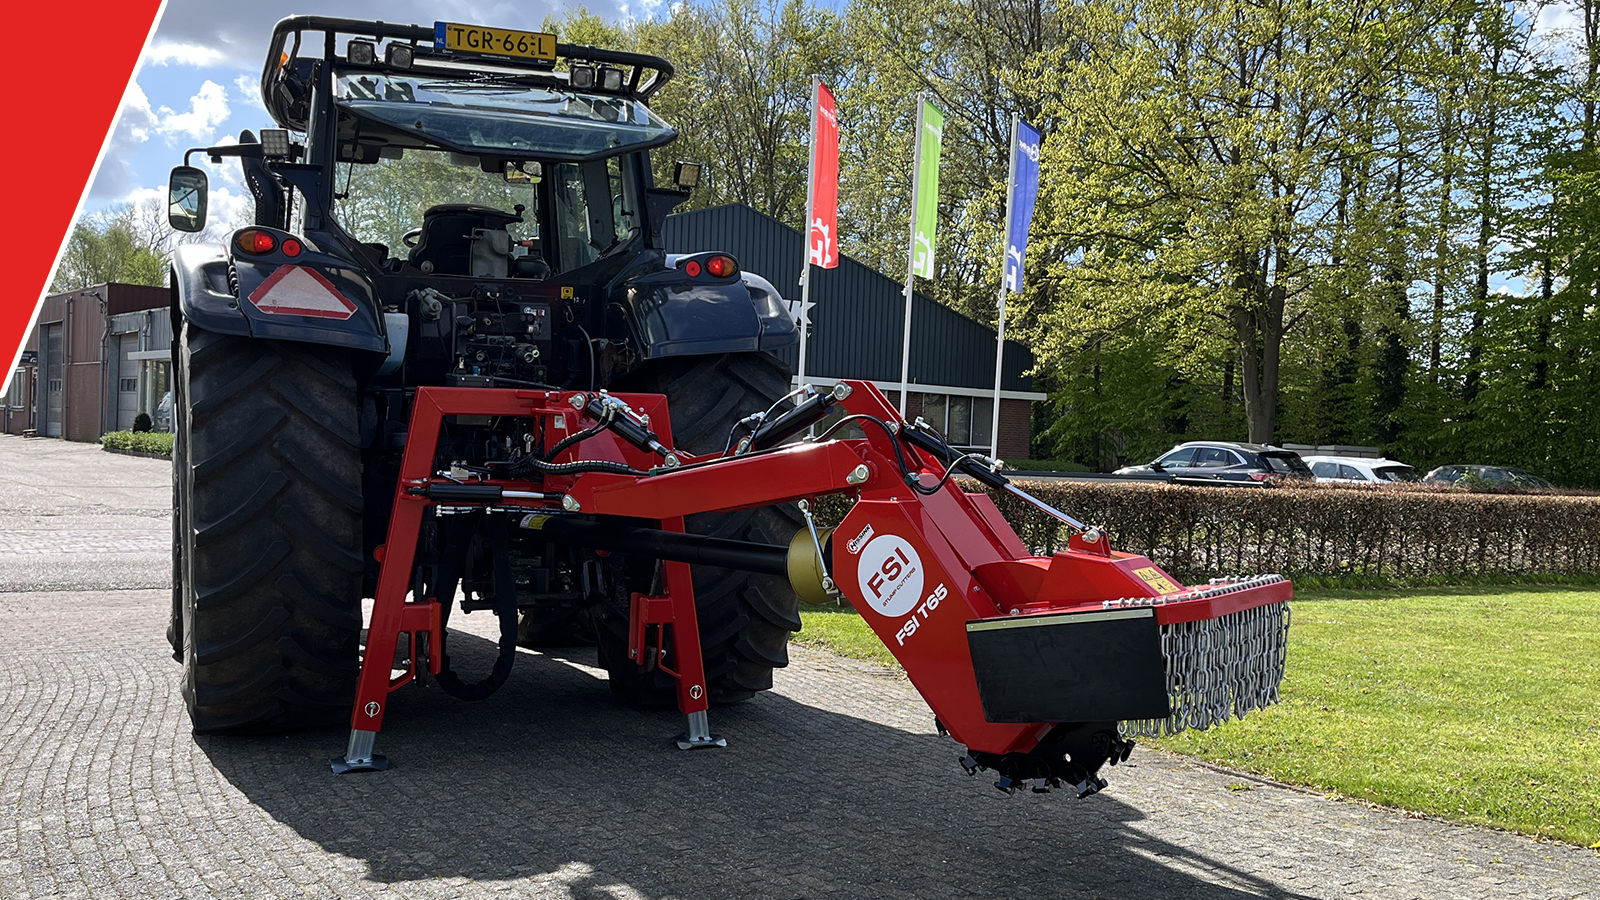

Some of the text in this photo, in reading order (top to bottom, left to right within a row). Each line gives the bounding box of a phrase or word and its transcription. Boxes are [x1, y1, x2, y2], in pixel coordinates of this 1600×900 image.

[436, 37, 445, 45] NL
[453, 27, 549, 56] TGR-66-L
[866, 546, 910, 600] FSI
[882, 566, 917, 607] STUMP CUTTERS
[895, 582, 949, 647] FSI T65
